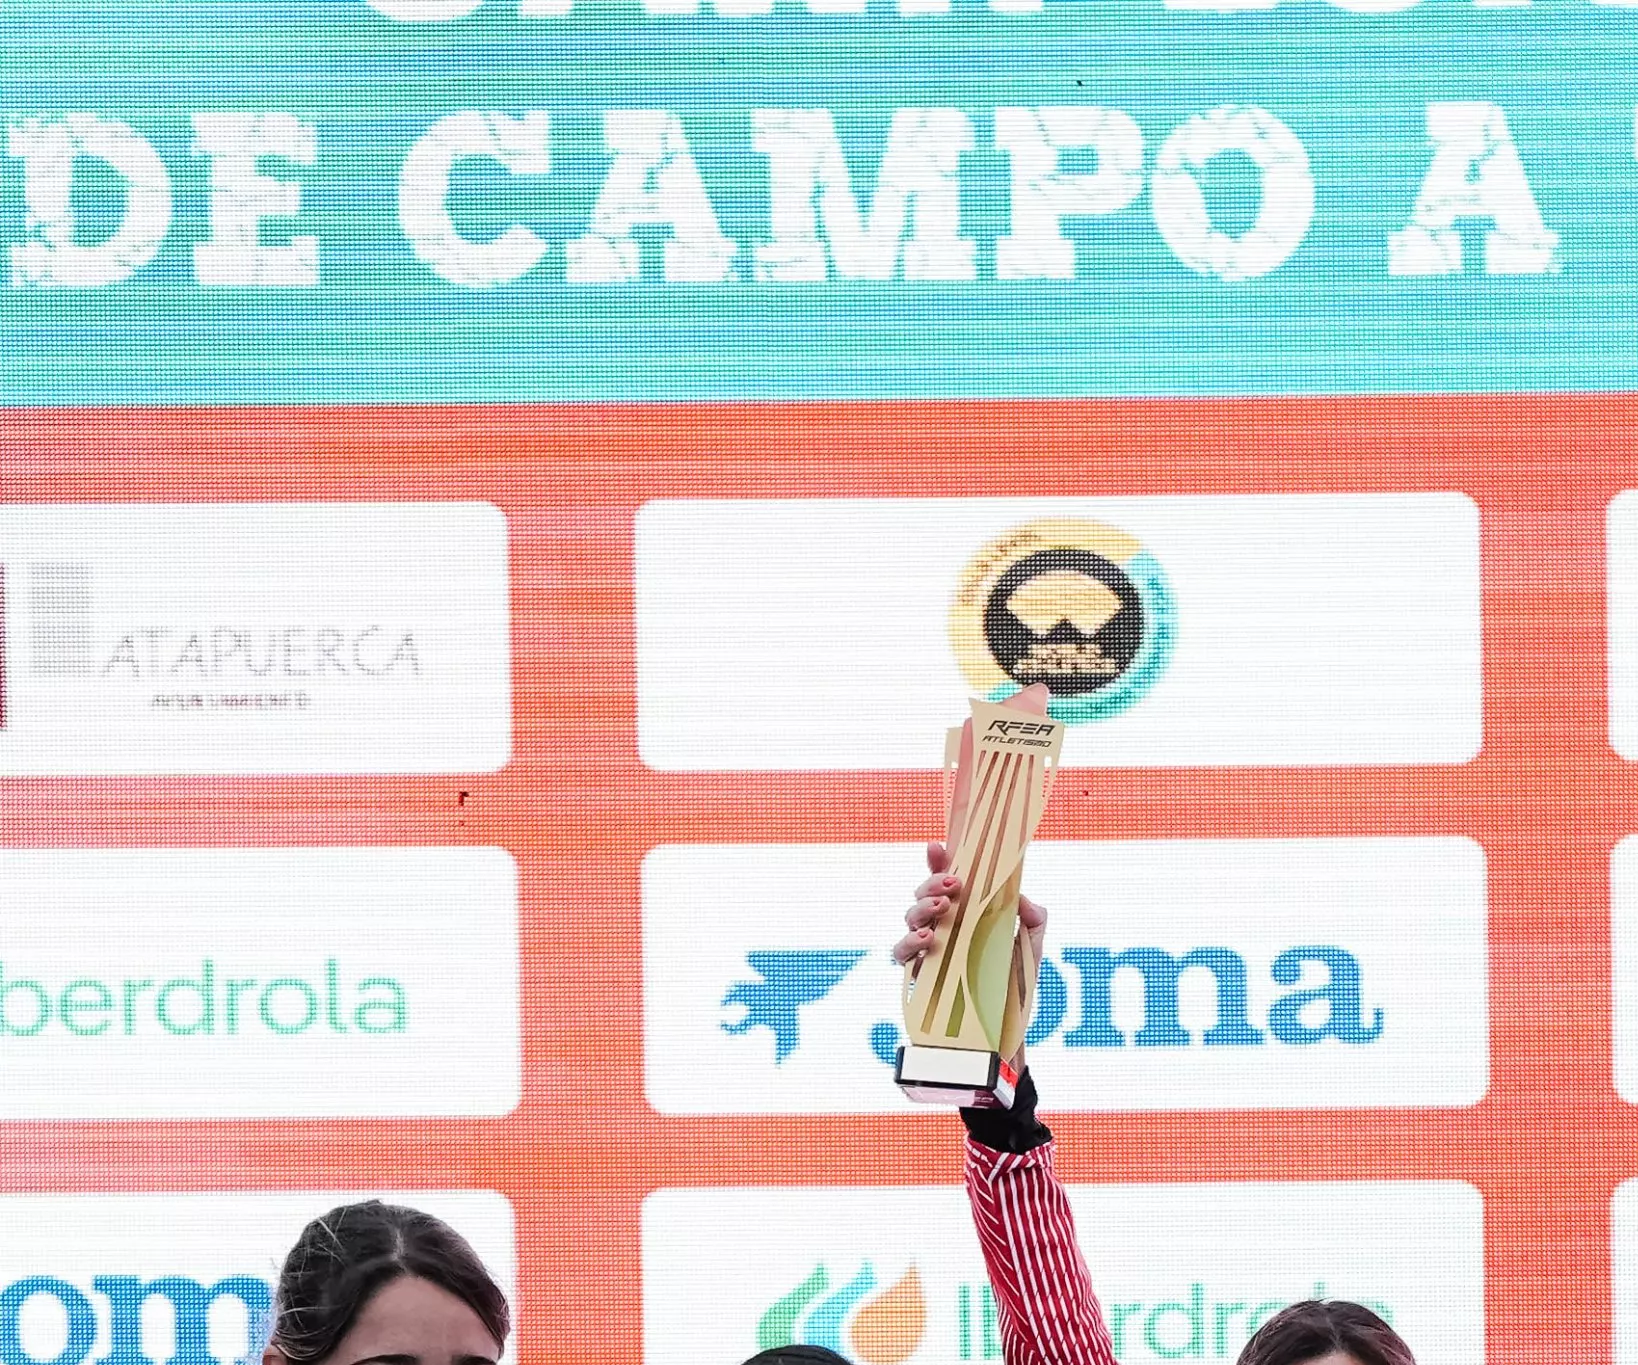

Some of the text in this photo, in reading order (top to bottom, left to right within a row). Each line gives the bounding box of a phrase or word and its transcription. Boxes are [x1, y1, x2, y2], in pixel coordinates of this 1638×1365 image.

[4, 112, 321, 287] DE
[398, 104, 1316, 287] CAMPO
[1387, 100, 1563, 275] A
[102, 624, 423, 677] ATAPUERCA
[982, 735, 1053, 748] ATLETISMO
[988, 719, 1057, 736] RFEA
